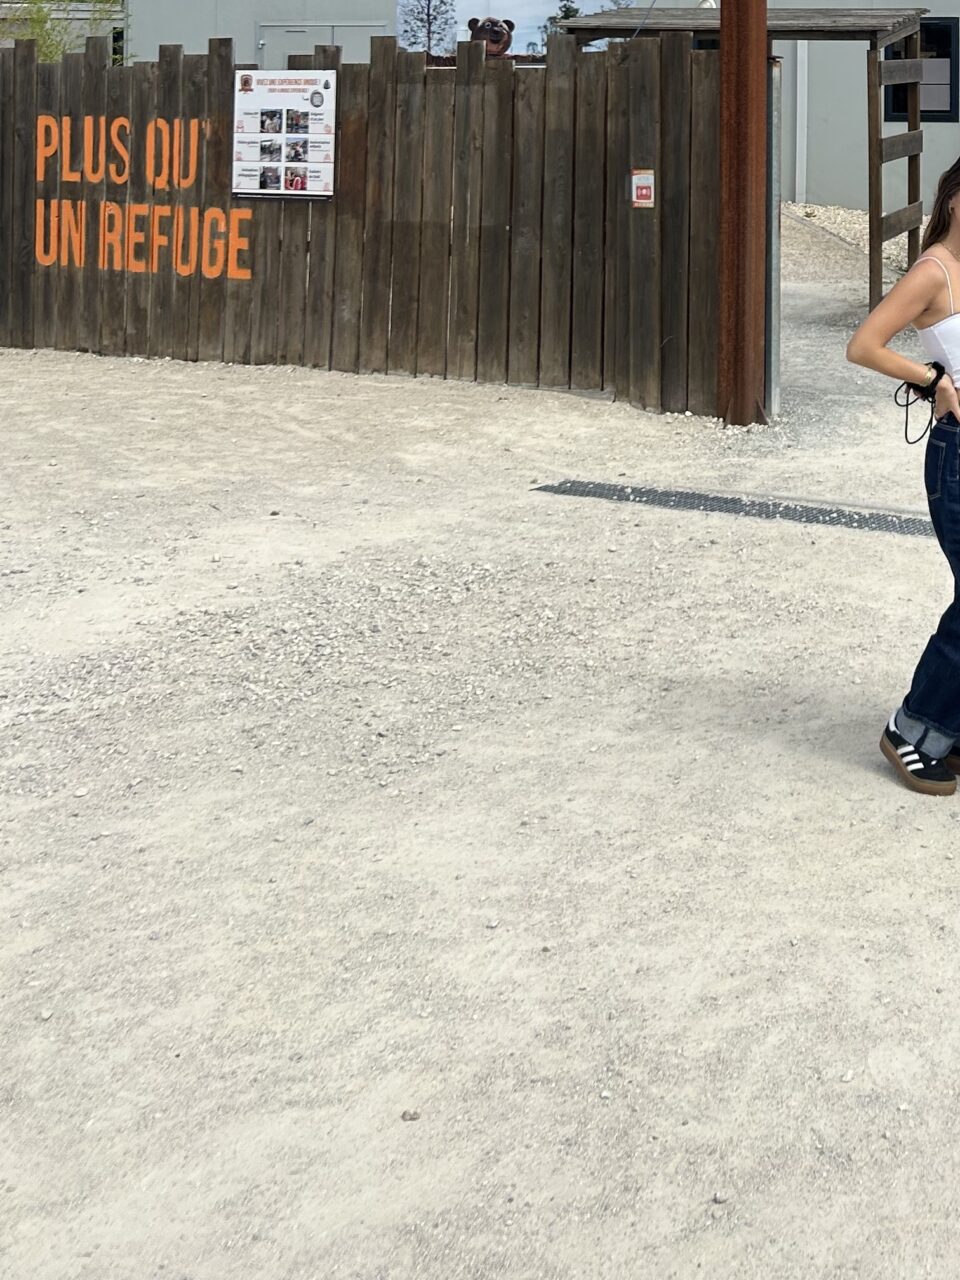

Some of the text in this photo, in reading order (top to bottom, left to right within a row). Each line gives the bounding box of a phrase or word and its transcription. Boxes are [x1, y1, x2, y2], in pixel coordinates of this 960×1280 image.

[36, 114, 132, 185] PLUS
[35, 199, 253, 280] UN REFUGE
